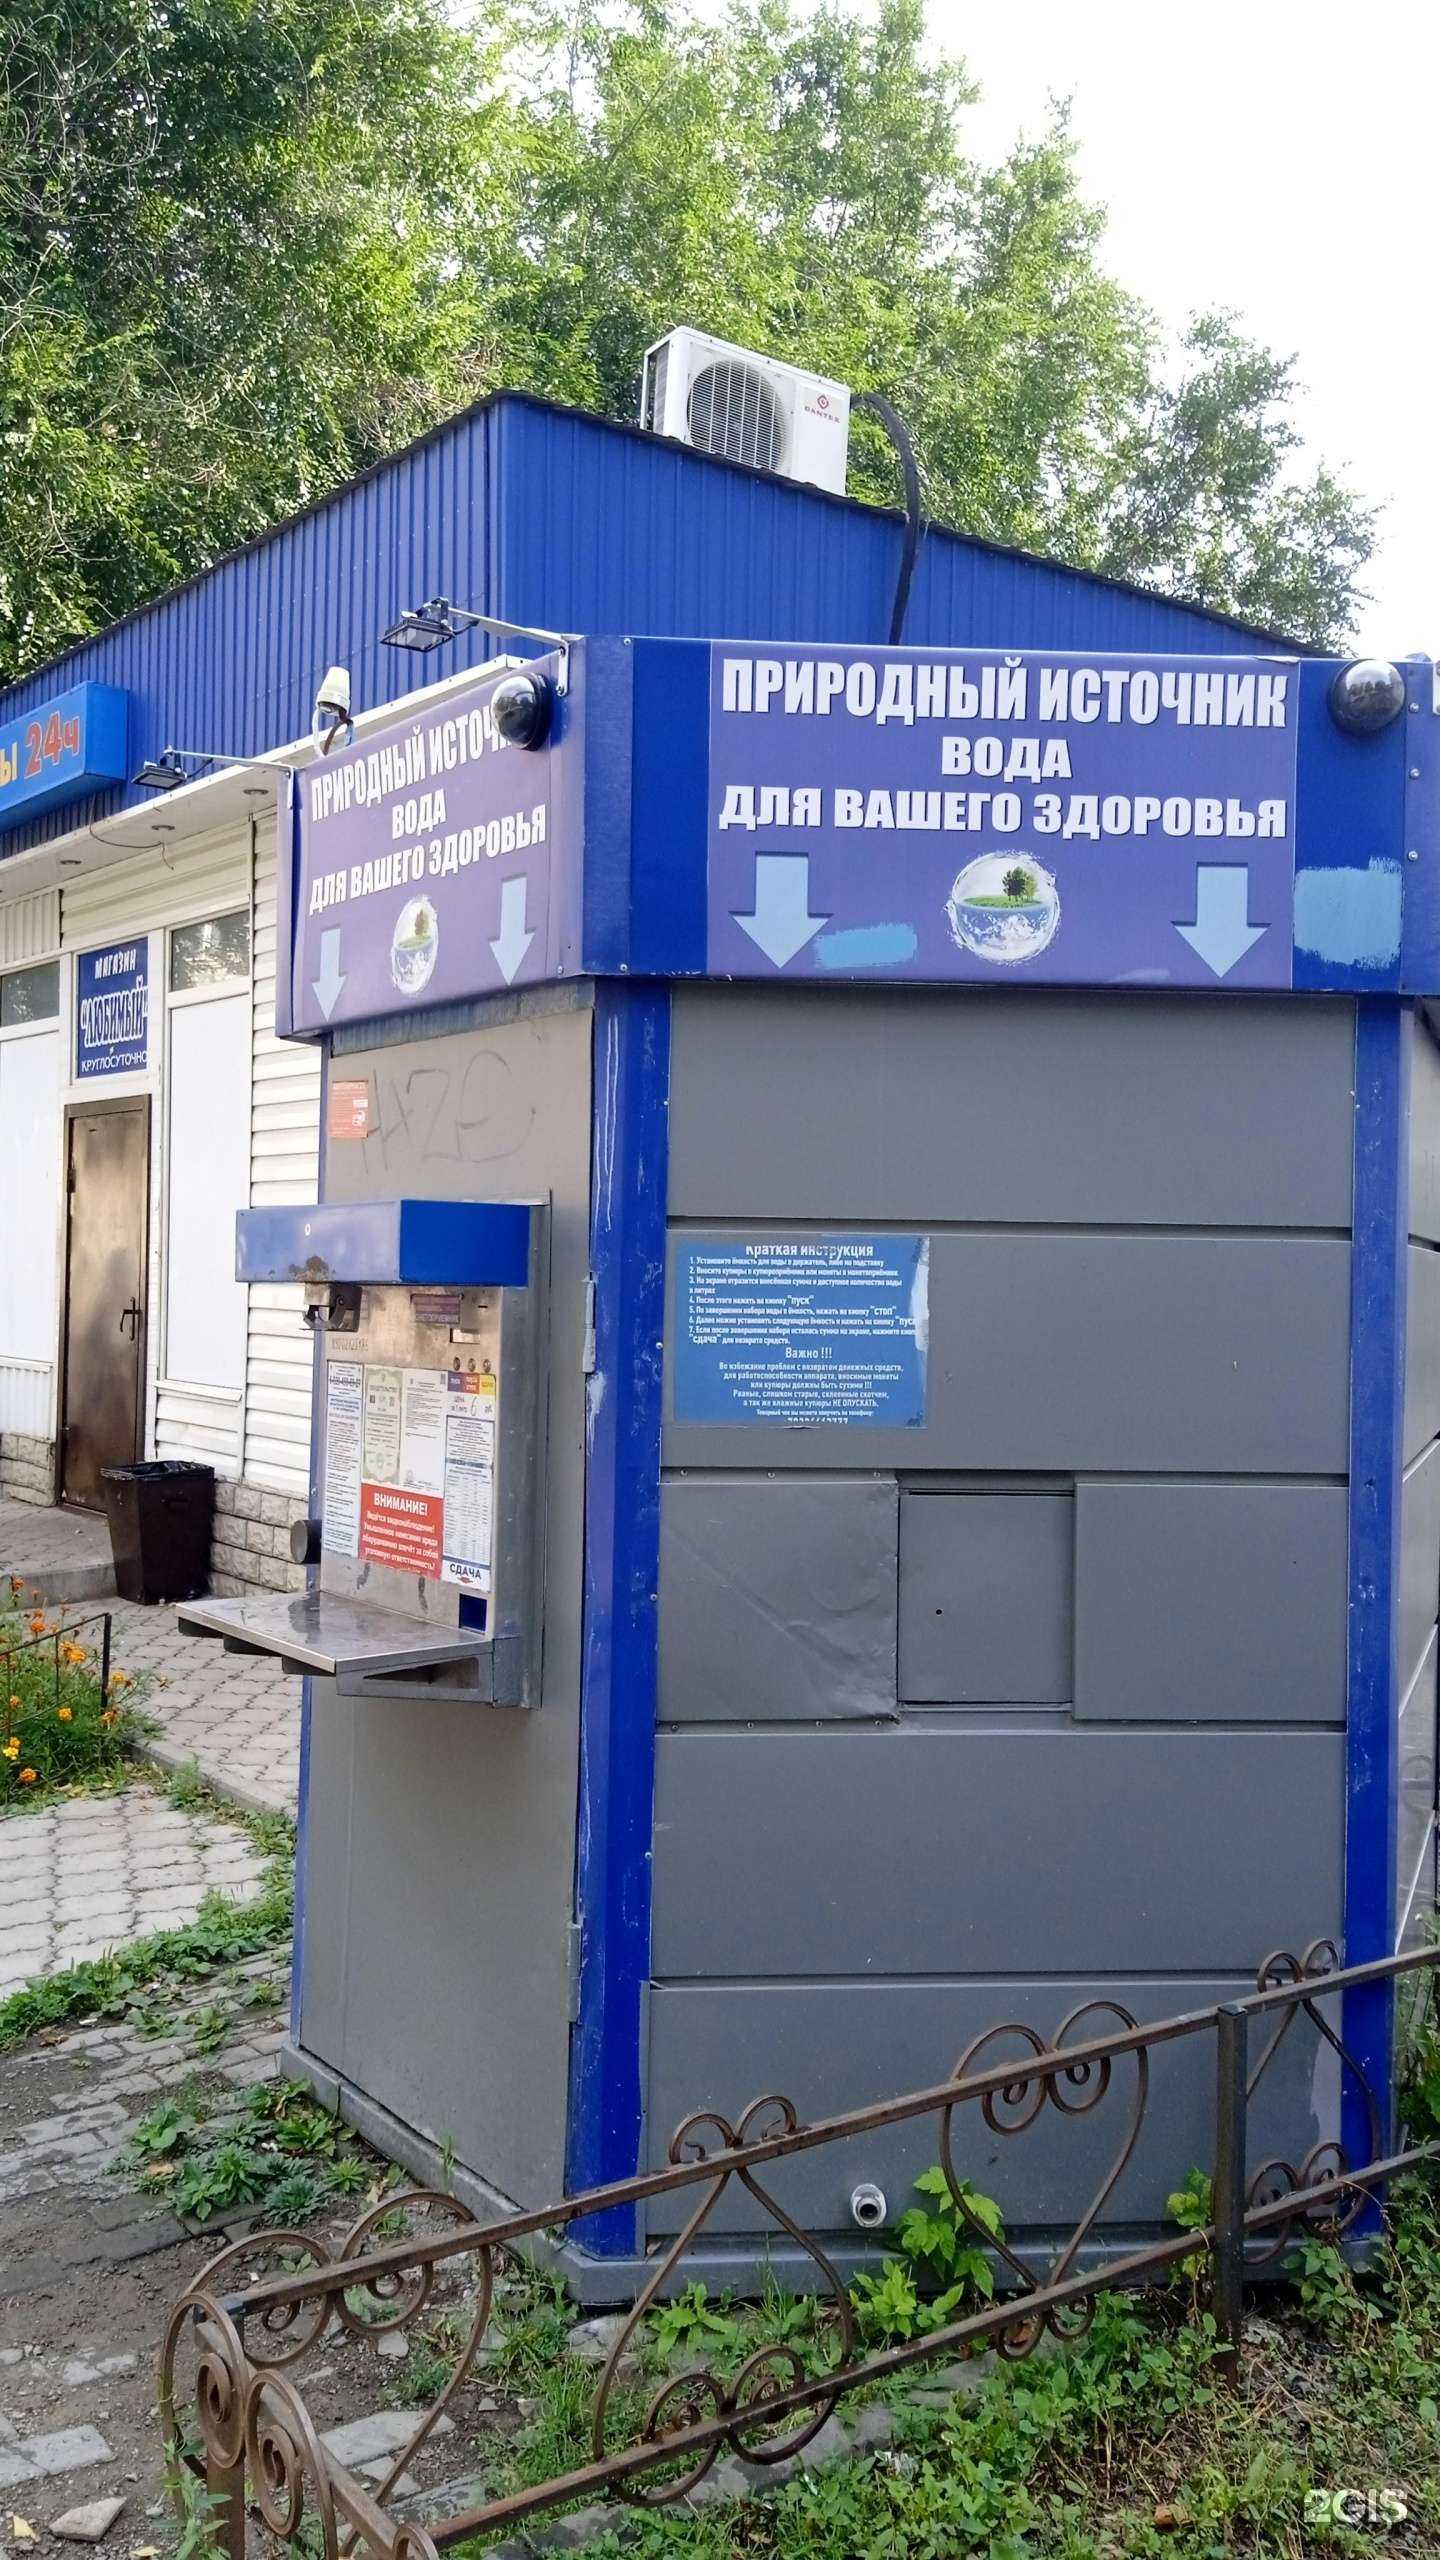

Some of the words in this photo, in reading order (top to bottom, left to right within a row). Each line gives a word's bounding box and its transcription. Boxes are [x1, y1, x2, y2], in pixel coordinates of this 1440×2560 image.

[723, 656, 1027, 726] ПРИРОДНЫЙ
[1039, 668, 1288, 727] ИСТОЧНИК
[311, 725, 426, 821] ПРИРОДНЫЙ
[942, 736, 1073, 783] ВОДА
[392, 788, 446, 839] ВОДА
[719, 785, 821, 831] ДЛЯ
[834, 788, 1022, 832] ВАШЕГО
[1033, 793, 1287, 840] ЗДОРОВЬЯ
[310, 870, 347, 915] ДЛЯ
[350, 845, 424, 899] ВАШЕГО
[429, 804, 546, 877] ЗДОРОВЬЯ
[95, 949, 136, 979] МАГАЗИН
[81, 1050, 147, 1072] КРУГЛОСУТОЧНО
[745, 1244, 797, 1258] Краткая
[800, 1244, 874, 1259] инструкция
[786, 1347, 818, 1358] Важно
[821, 1347, 832, 1358] !!!
[374, 1493, 428, 1516] ВНИМАНИЕ!
[450, 1563, 482, 1580] СДАЧА
